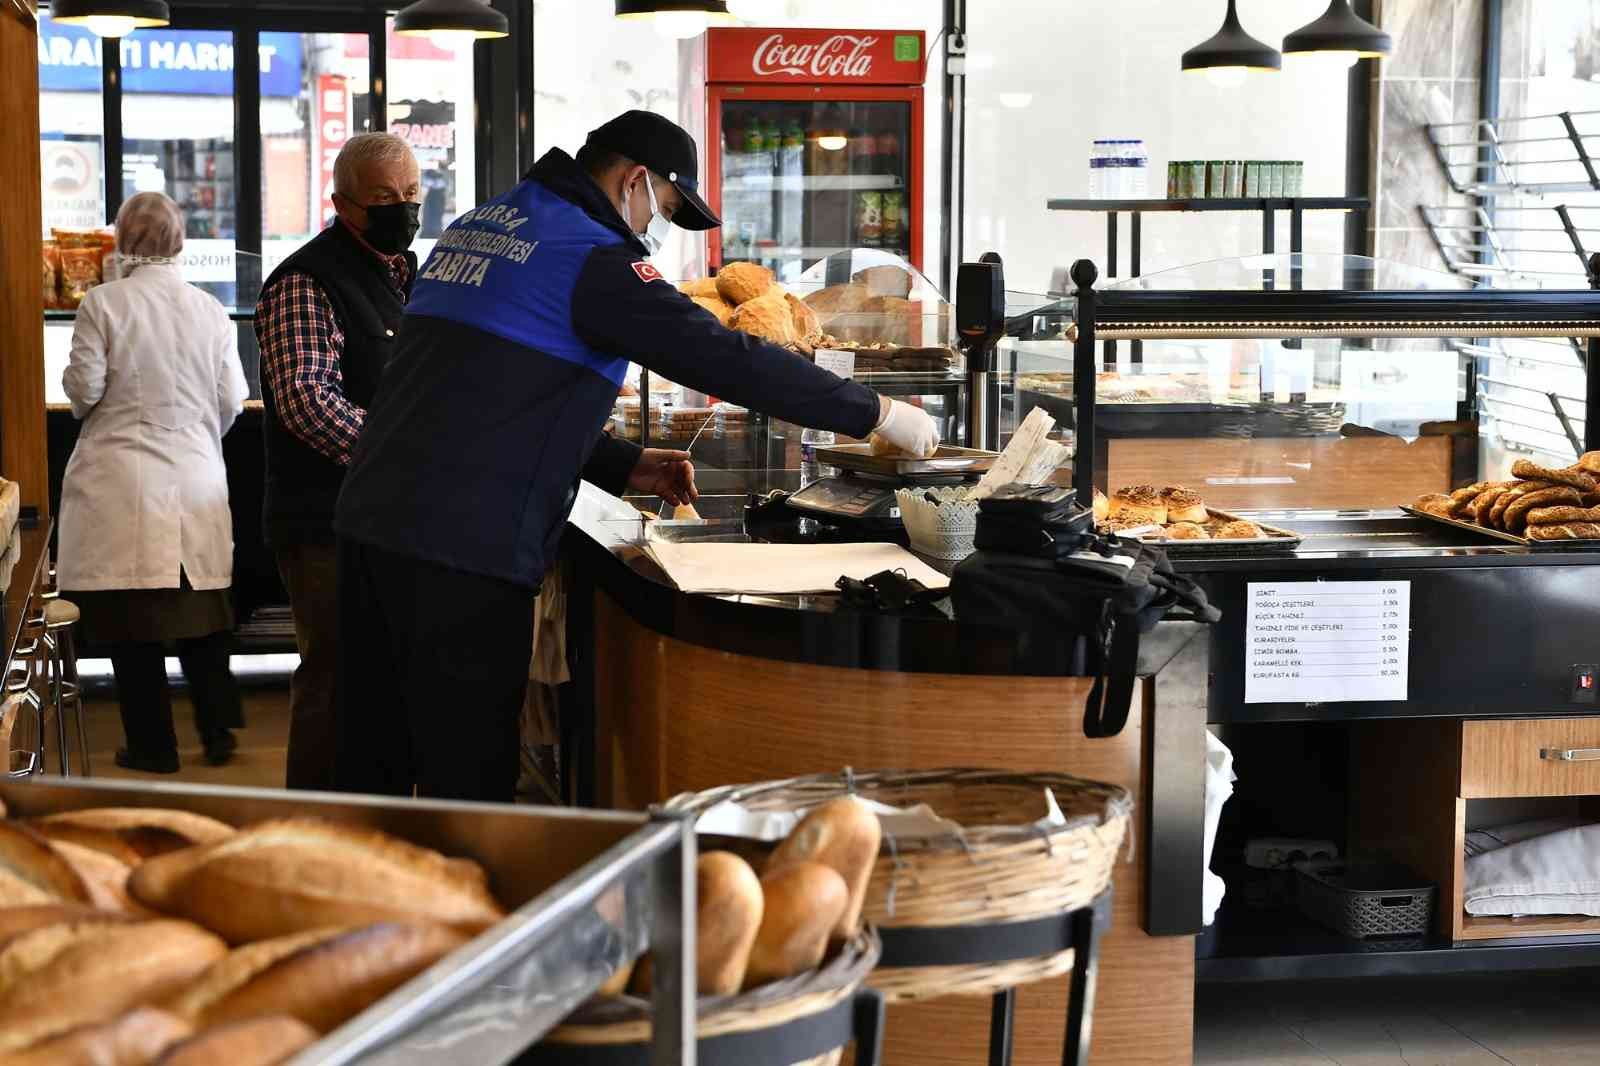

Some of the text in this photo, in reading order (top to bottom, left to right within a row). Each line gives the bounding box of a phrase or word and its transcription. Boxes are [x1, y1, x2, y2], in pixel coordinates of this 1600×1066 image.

[150, 41, 276, 73] MARKT
[752, 34, 880, 77] Coca-Cola
[461, 204, 528, 232] BURSA
[422, 251, 491, 287] ZABITA
